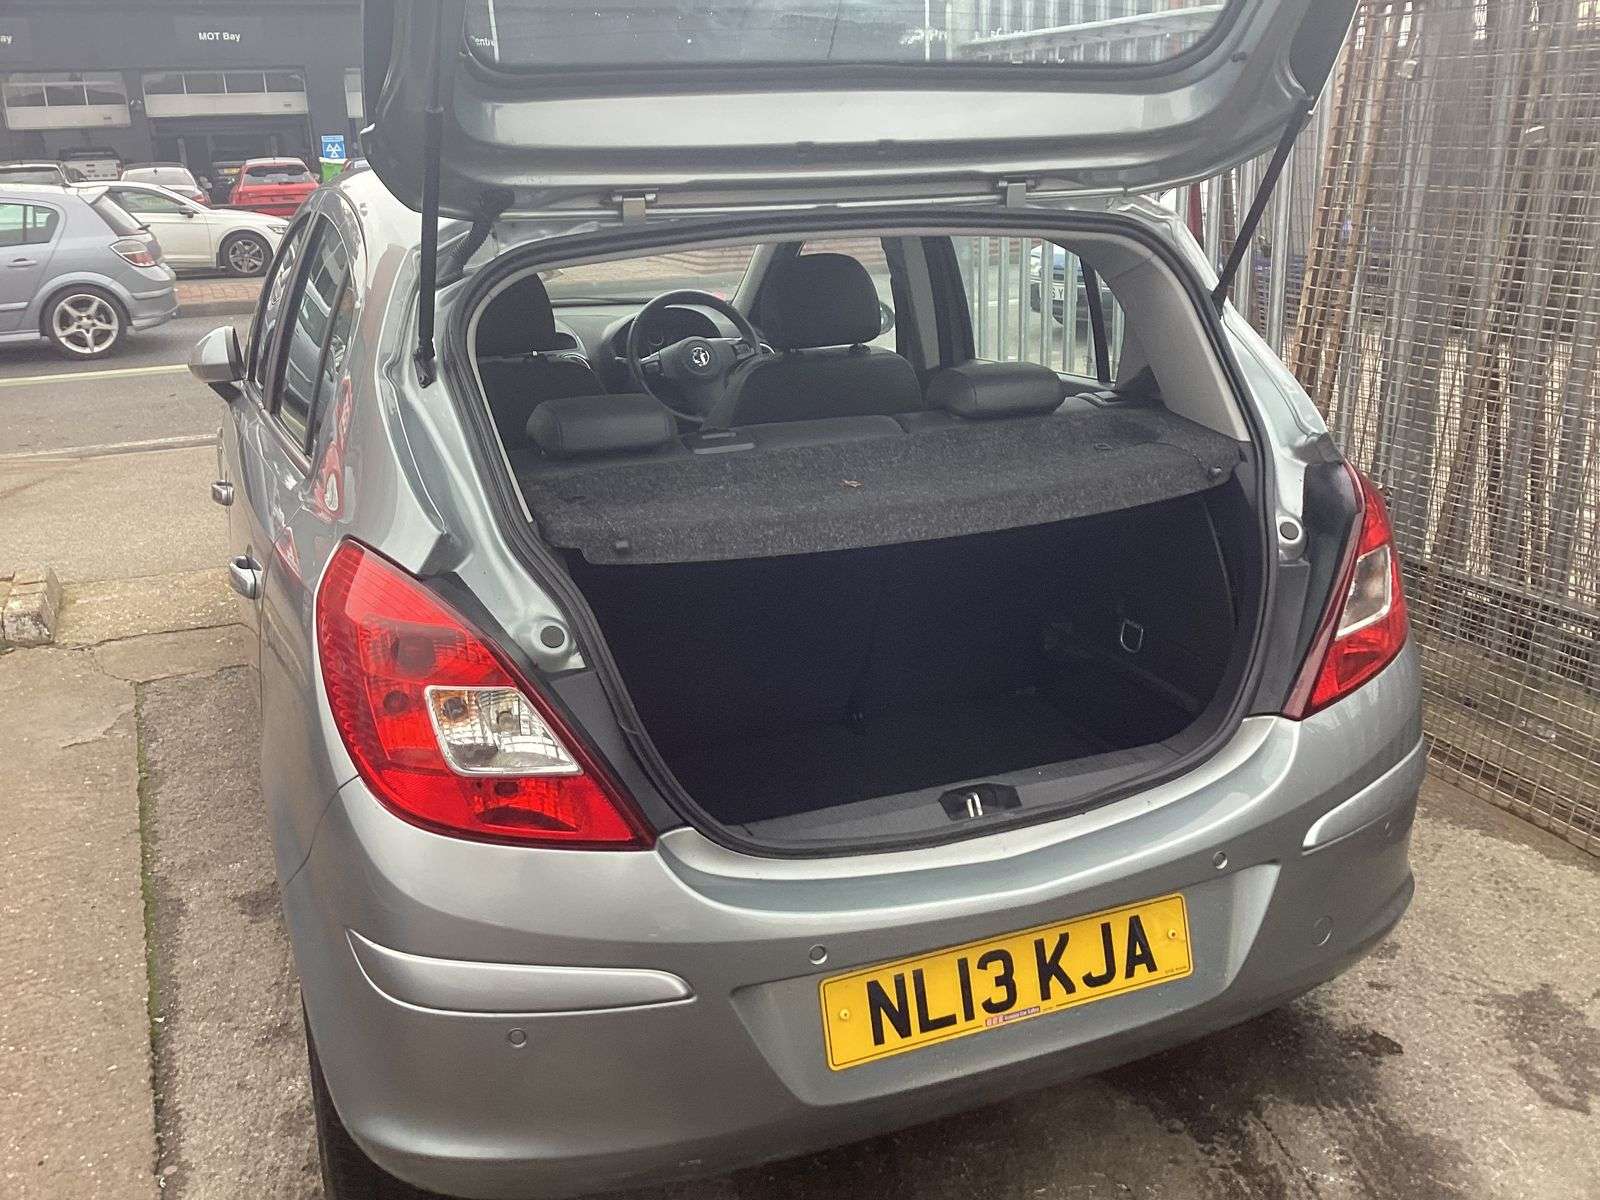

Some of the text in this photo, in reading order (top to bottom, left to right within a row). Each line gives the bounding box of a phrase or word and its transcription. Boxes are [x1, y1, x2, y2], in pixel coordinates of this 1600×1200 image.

[0, 35, 13, 45] ay
[198, 31, 241, 43] MOT Bay
[866, 914, 1158, 1047] NL13 KJA
